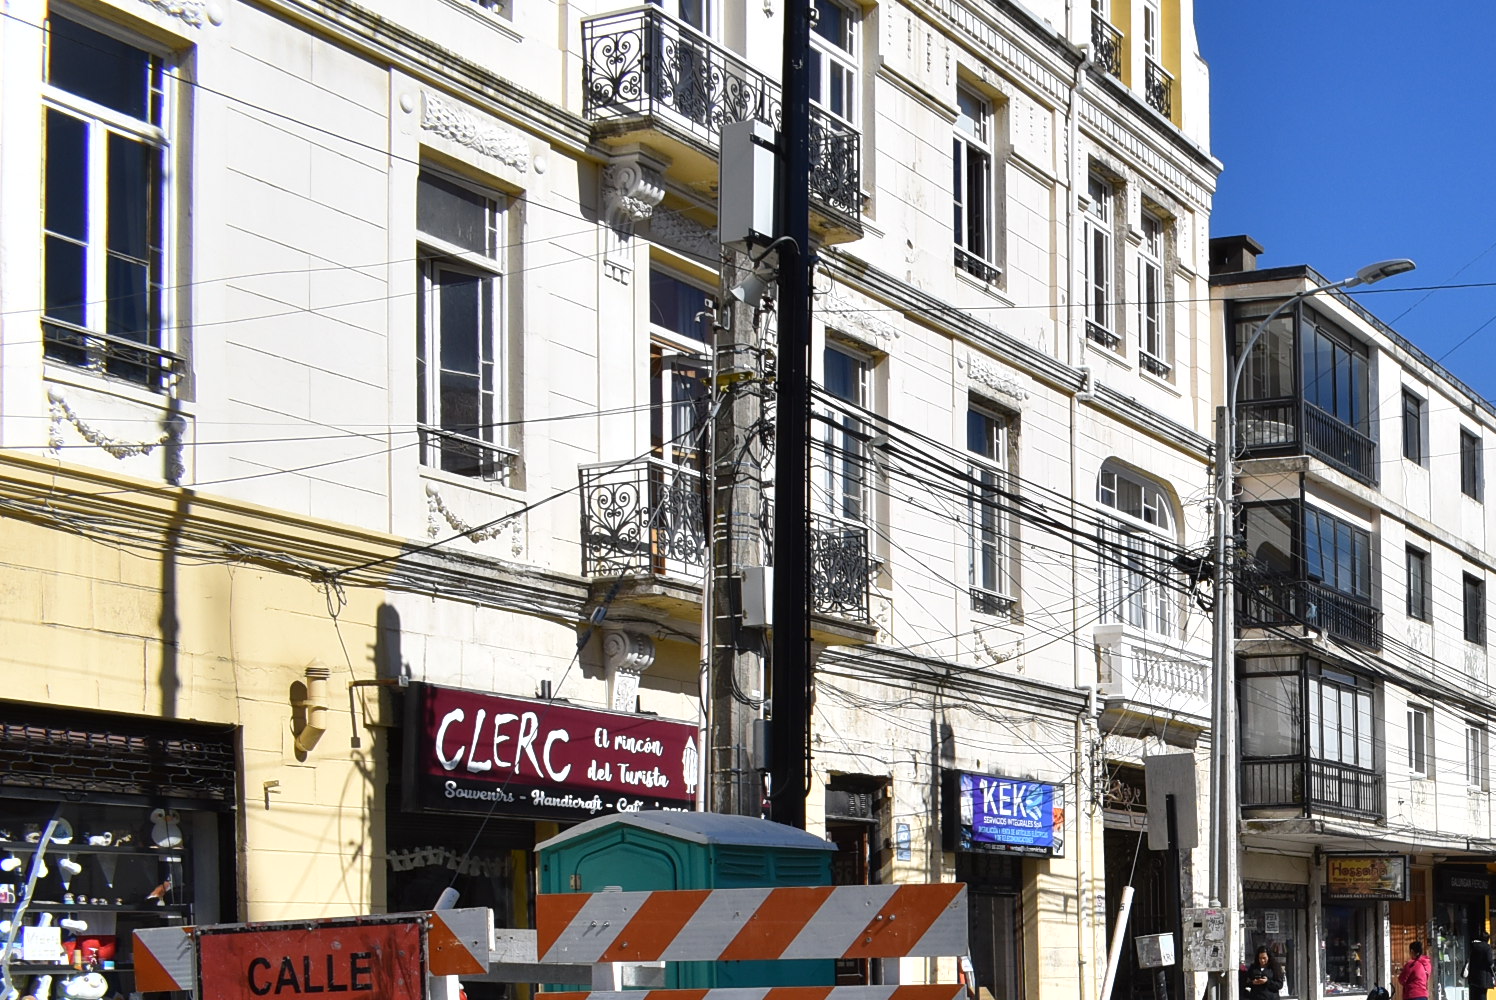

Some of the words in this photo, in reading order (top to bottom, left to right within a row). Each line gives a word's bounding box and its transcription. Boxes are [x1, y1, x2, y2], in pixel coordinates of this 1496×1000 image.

[435, 708, 572, 782] CLERC
[594, 727, 609, 748] El
[614, 734, 664, 757] rincón
[587, 760, 612, 782] del
[616, 762, 670, 789] Turista
[444, 780, 515, 804] Souvenirs
[530, 789, 603, 815] Handicraft
[247, 951, 373, 996] CALLE
